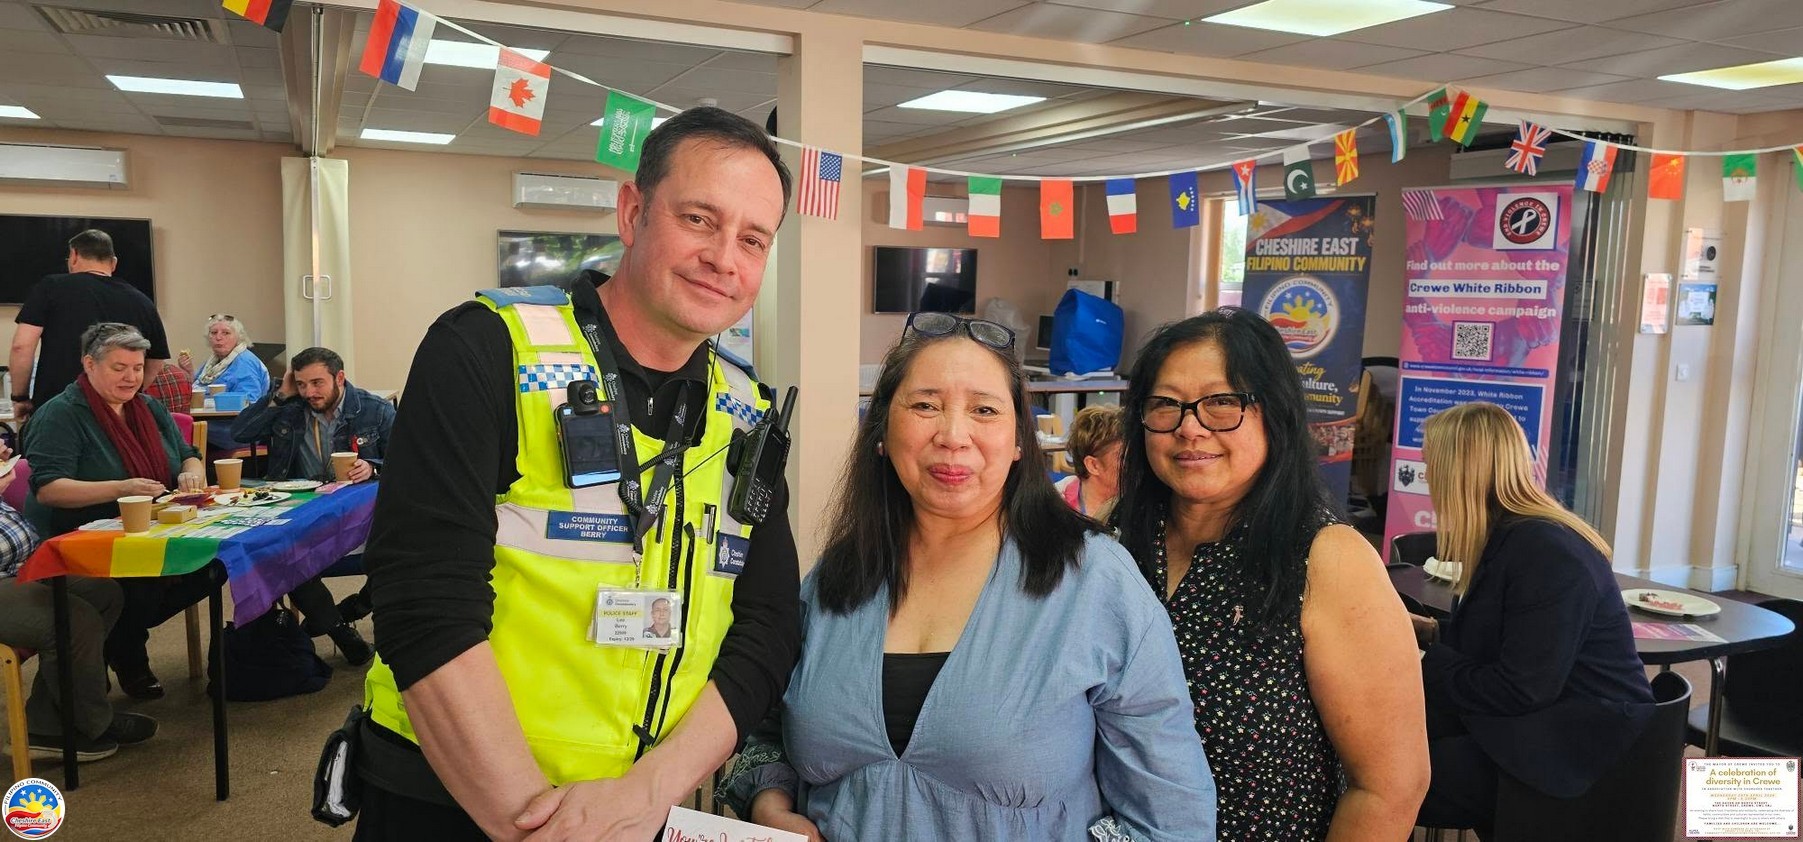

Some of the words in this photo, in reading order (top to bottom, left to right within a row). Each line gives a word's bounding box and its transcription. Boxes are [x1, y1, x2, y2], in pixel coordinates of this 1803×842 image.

[1255, 237, 1319, 256] CHESHIRE
[1321, 237, 1359, 255] EAST
[1246, 256, 1291, 271] FILIPINO
[1293, 256, 1366, 273] COMMUNITY
[1406, 259, 1428, 271] Find
[1430, 260, 1452, 271] out
[1455, 261, 1491, 271] more
[1491, 260, 1534, 272] about
[1535, 259, 1560, 272] the
[1266, 281, 1291, 309] FILIPINO
[1292, 279, 1334, 307] COMMUNITY
[1410, 282, 1450, 294] Crewe
[1453, 282, 1491, 294] White
[1494, 283, 1542, 295] Ribbon
[1405, 303, 1486, 315] anti-violence
[1488, 305, 1557, 319] campaign
[1301, 377, 1339, 393] ulture,
[1414, 385, 1422, 393] In
[1423, 386, 1456, 395] November
[1477, 390, 1498, 399] White
[1498, 391, 1524, 400] Ribbon
[1408, 395, 1453, 405] Accreditation
[1504, 404, 1529, 412] Crewe
[1409, 405, 1427, 413] Town
[558, 522, 596, 531] SUPPORT
[596, 523, 629, 533] OFFICER
[571, 515, 619, 525] COMMUNITY
[580, 530, 607, 539] BERRY
